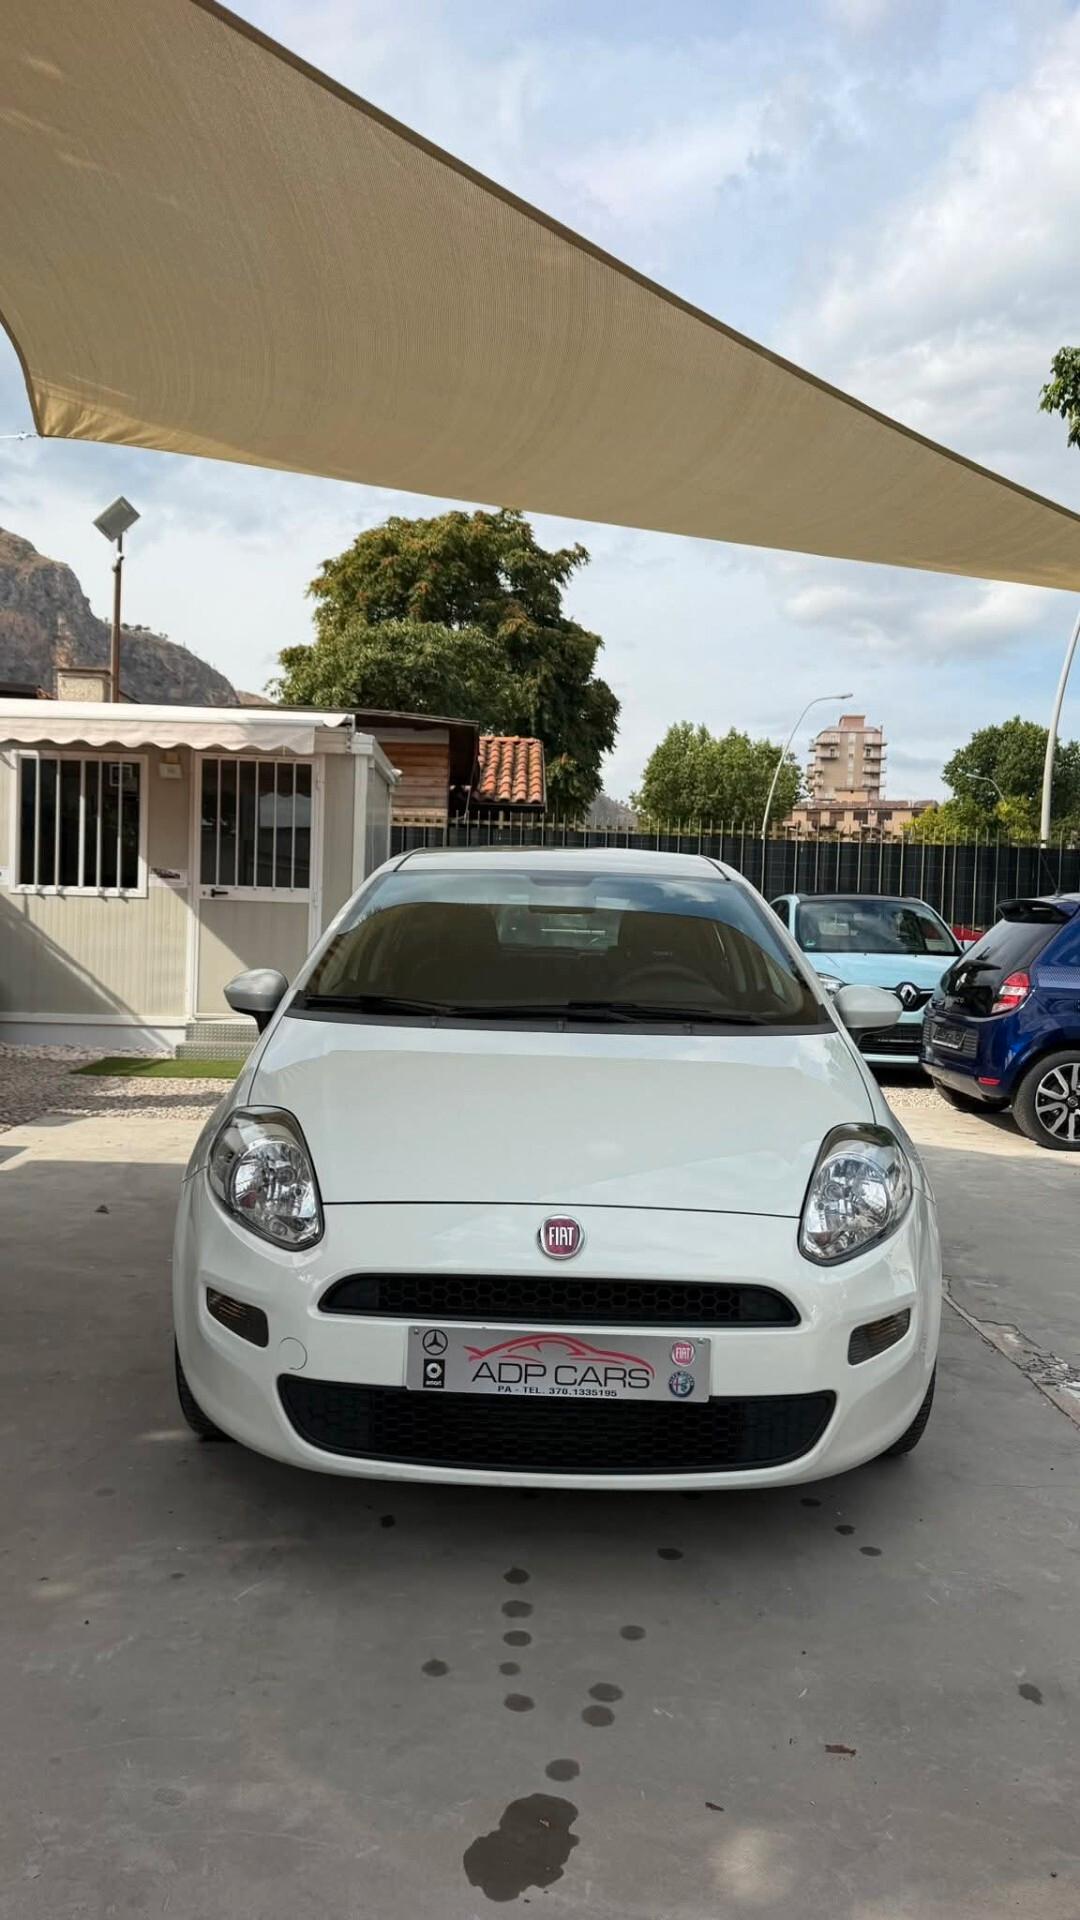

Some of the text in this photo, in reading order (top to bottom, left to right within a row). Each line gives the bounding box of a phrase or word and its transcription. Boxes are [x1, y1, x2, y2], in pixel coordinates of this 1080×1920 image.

[549, 1226, 574, 1246] FIAT
[676, 1347, 691, 1360] FIAT
[472, 1362, 547, 1385] ADP
[554, 1365, 650, 1389] CARS
[523, 1386, 545, 1394] TEL.
